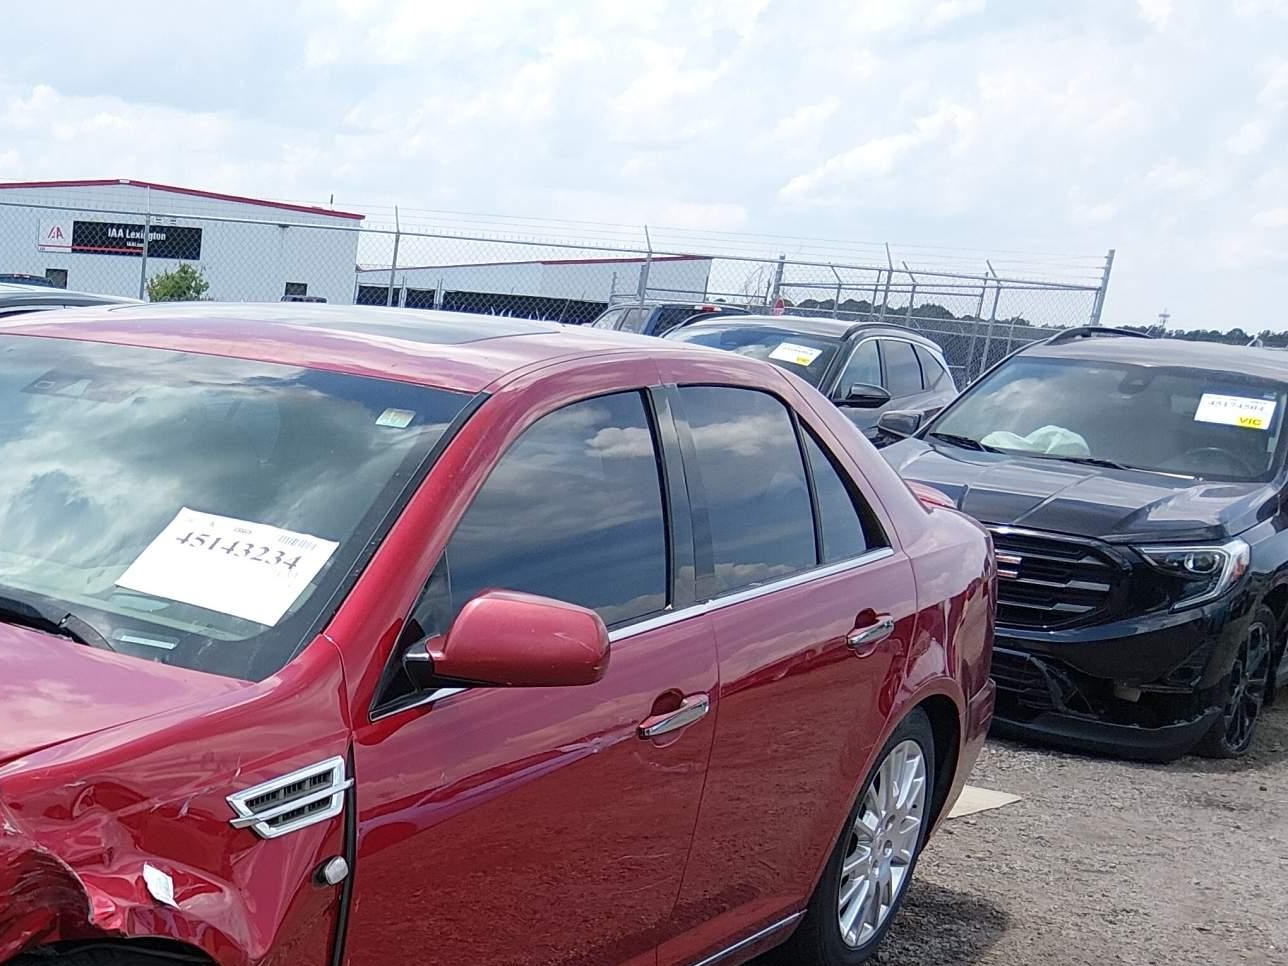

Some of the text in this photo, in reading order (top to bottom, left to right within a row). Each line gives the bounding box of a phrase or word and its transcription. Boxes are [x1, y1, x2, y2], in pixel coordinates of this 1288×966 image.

[107, 228, 166, 241] IAA Lexigton
[1240, 417, 1262, 426] VIC
[175, 531, 302, 570] 45143234
